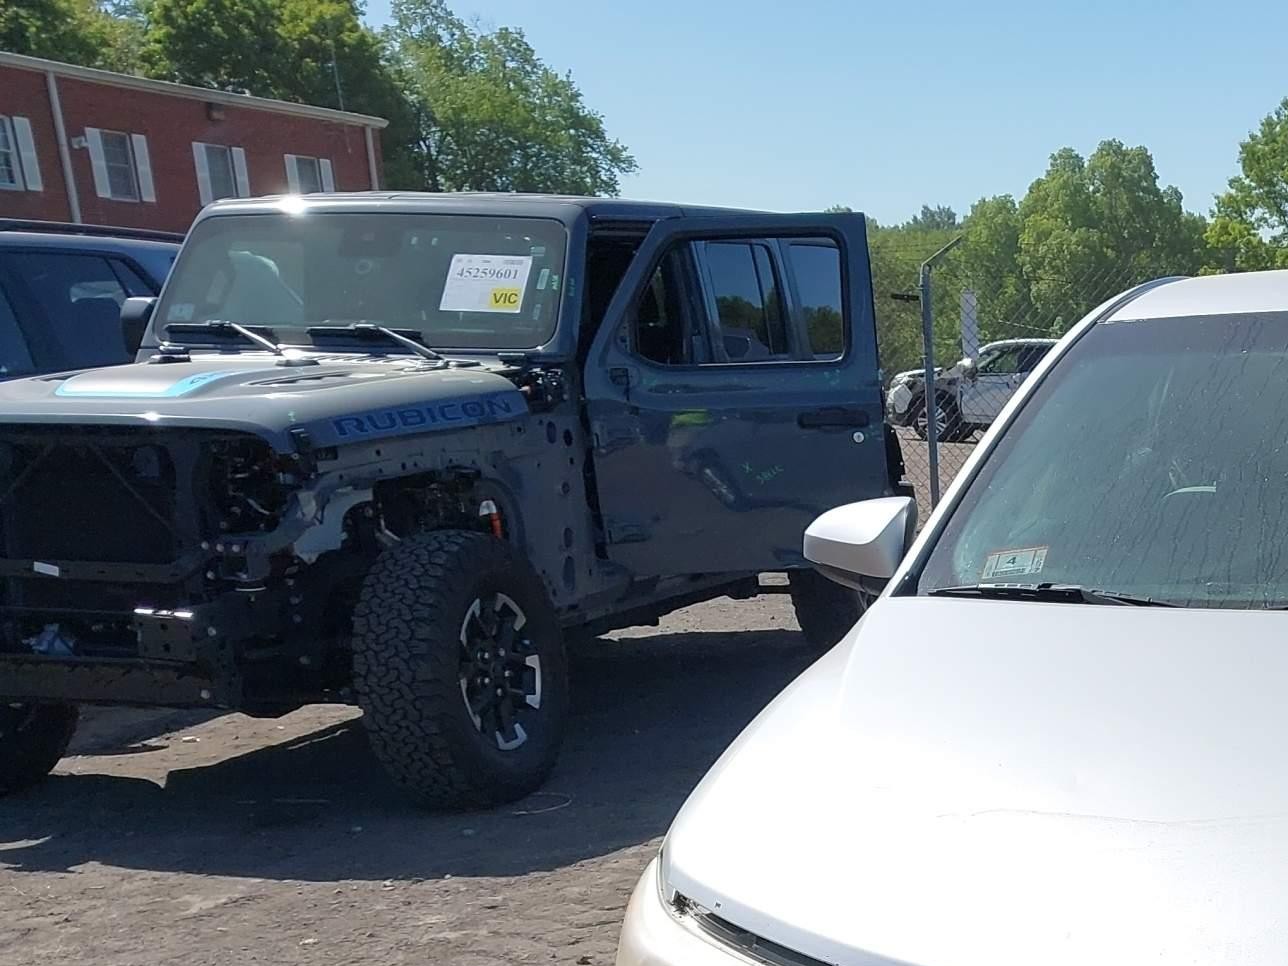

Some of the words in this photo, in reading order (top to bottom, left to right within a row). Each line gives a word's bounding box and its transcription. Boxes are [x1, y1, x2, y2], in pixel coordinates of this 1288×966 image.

[456, 267, 519, 279] 45259601
[493, 292, 518, 304] VIC
[331, 399, 513, 436] RUBICON
[1006, 556, 1017, 565] 4
